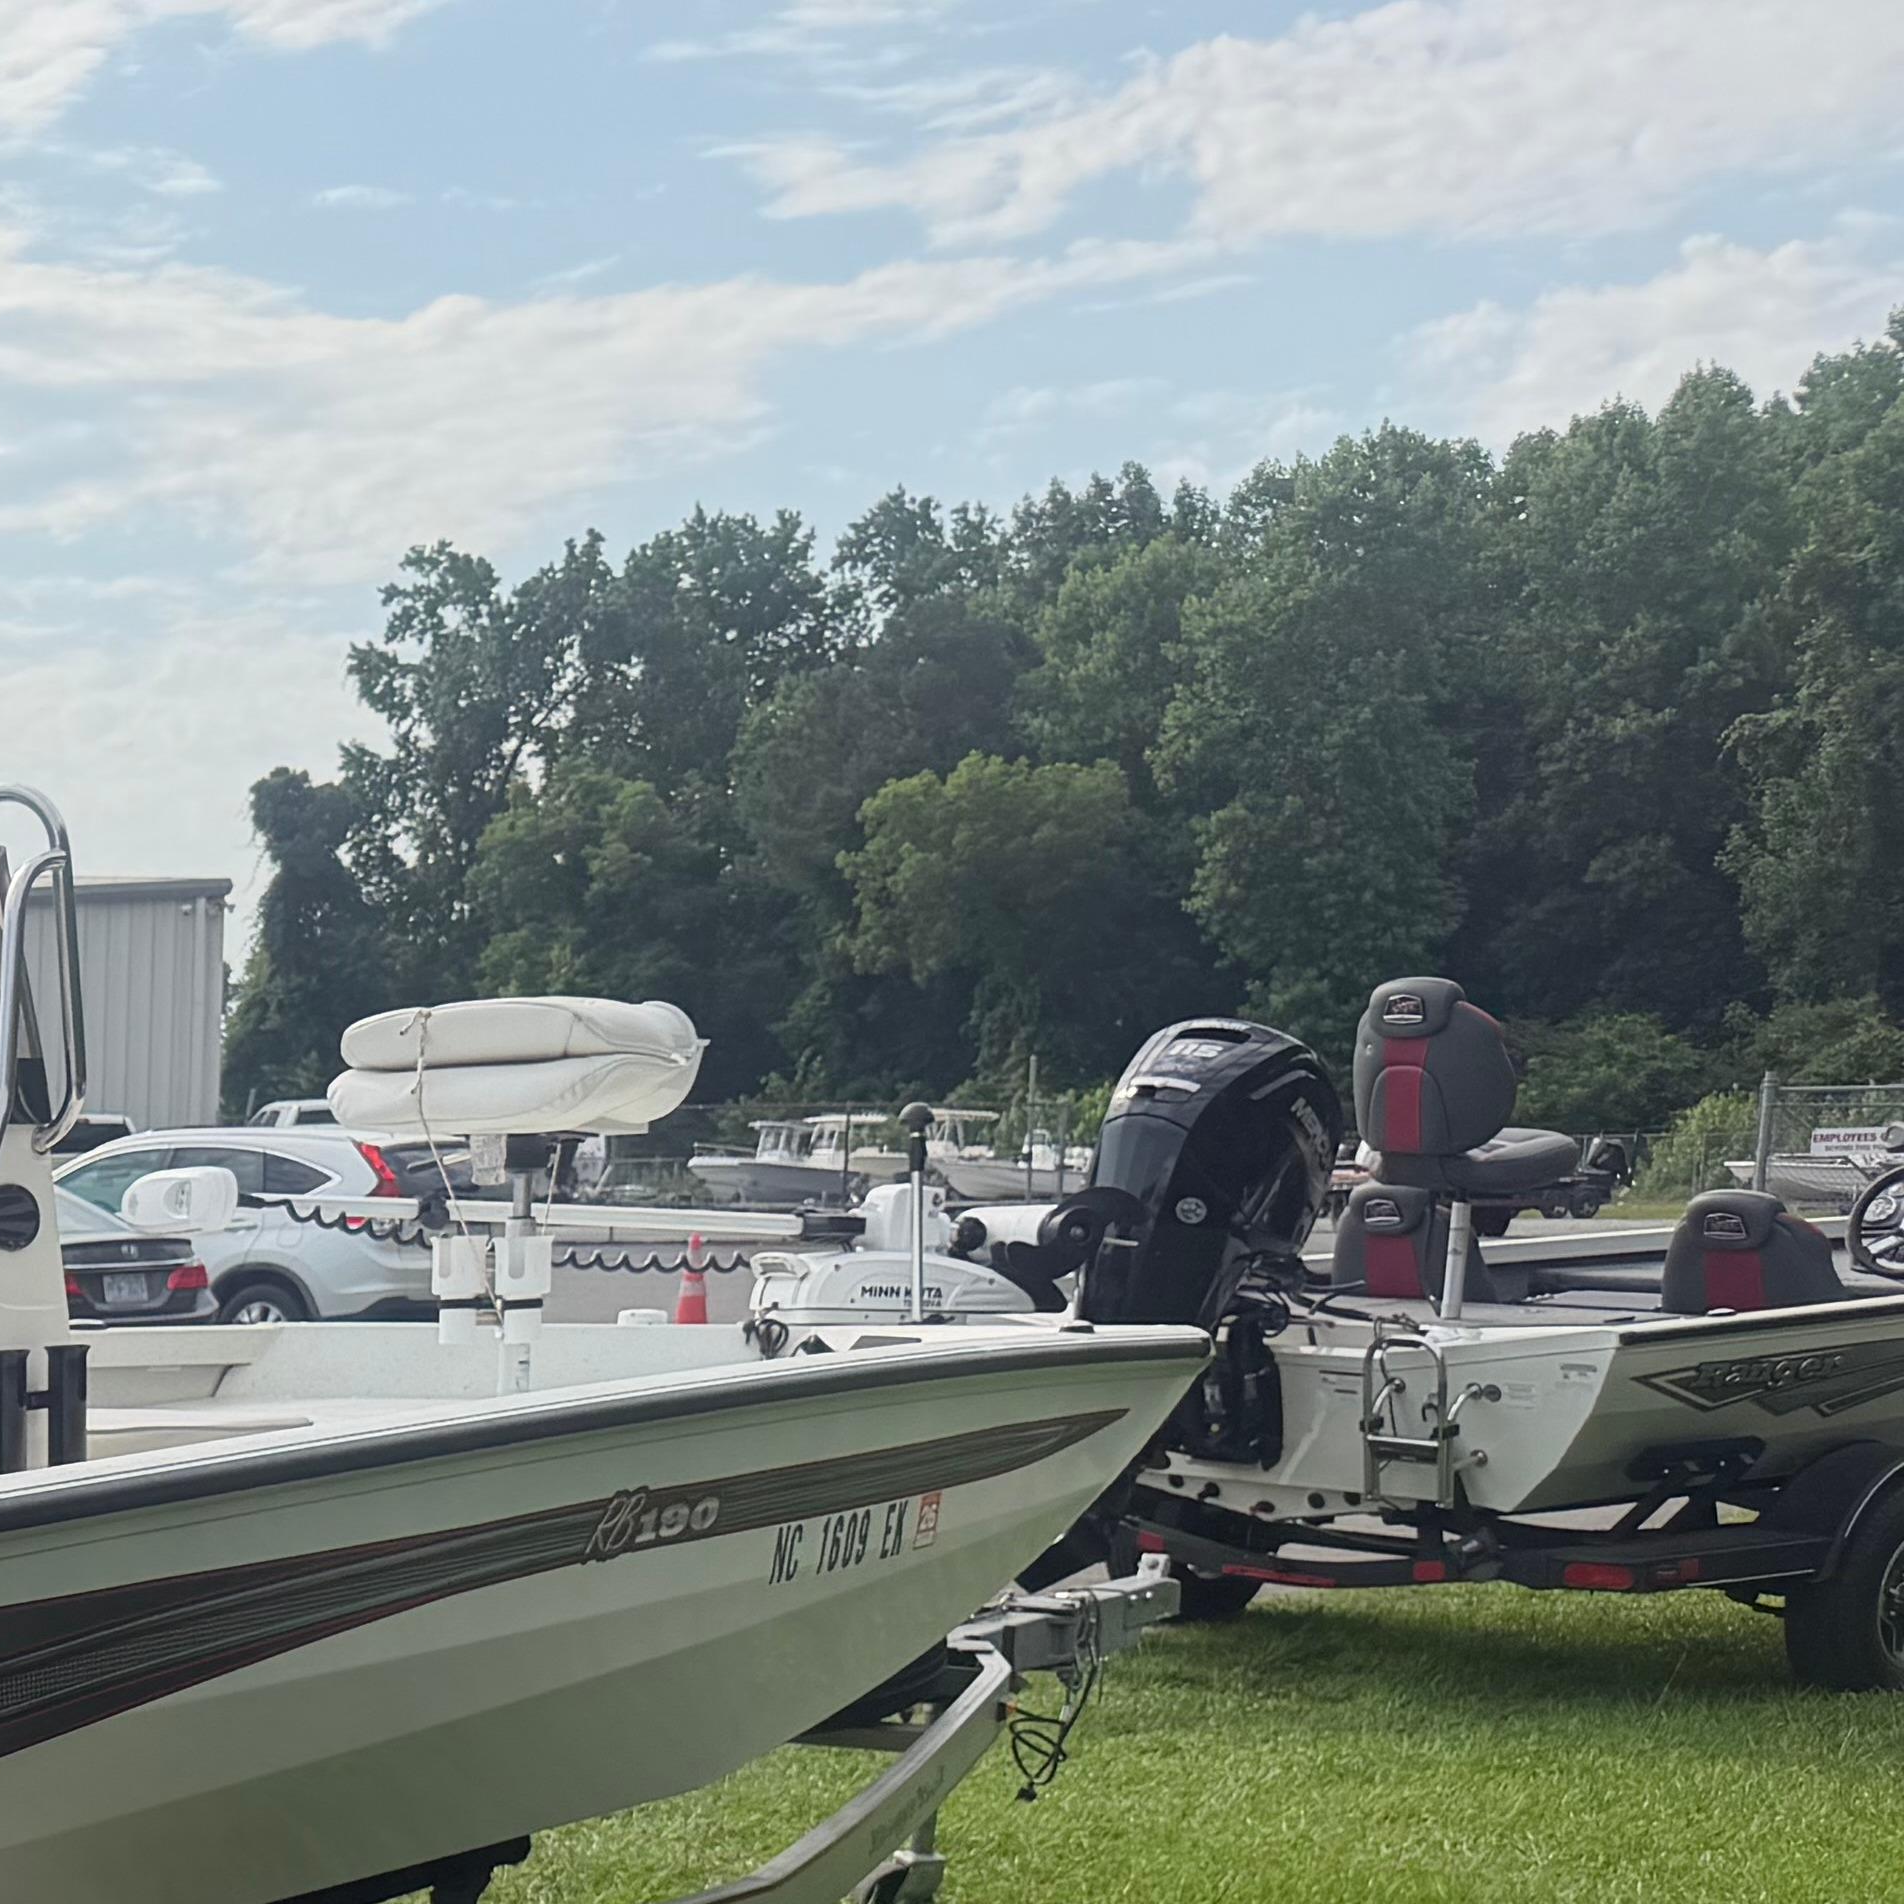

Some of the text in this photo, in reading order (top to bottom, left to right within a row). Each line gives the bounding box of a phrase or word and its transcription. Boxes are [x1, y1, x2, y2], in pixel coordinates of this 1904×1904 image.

[1168, 1042, 1225, 1059] 115
[1813, 1132, 1877, 1143] EMPLOYEES
[860, 1285, 943, 1299] MINN KTA
[1691, 1353, 1844, 1391] Ranger
[769, 1523, 803, 1585] NC
[816, 1508, 871, 1575] 1609
